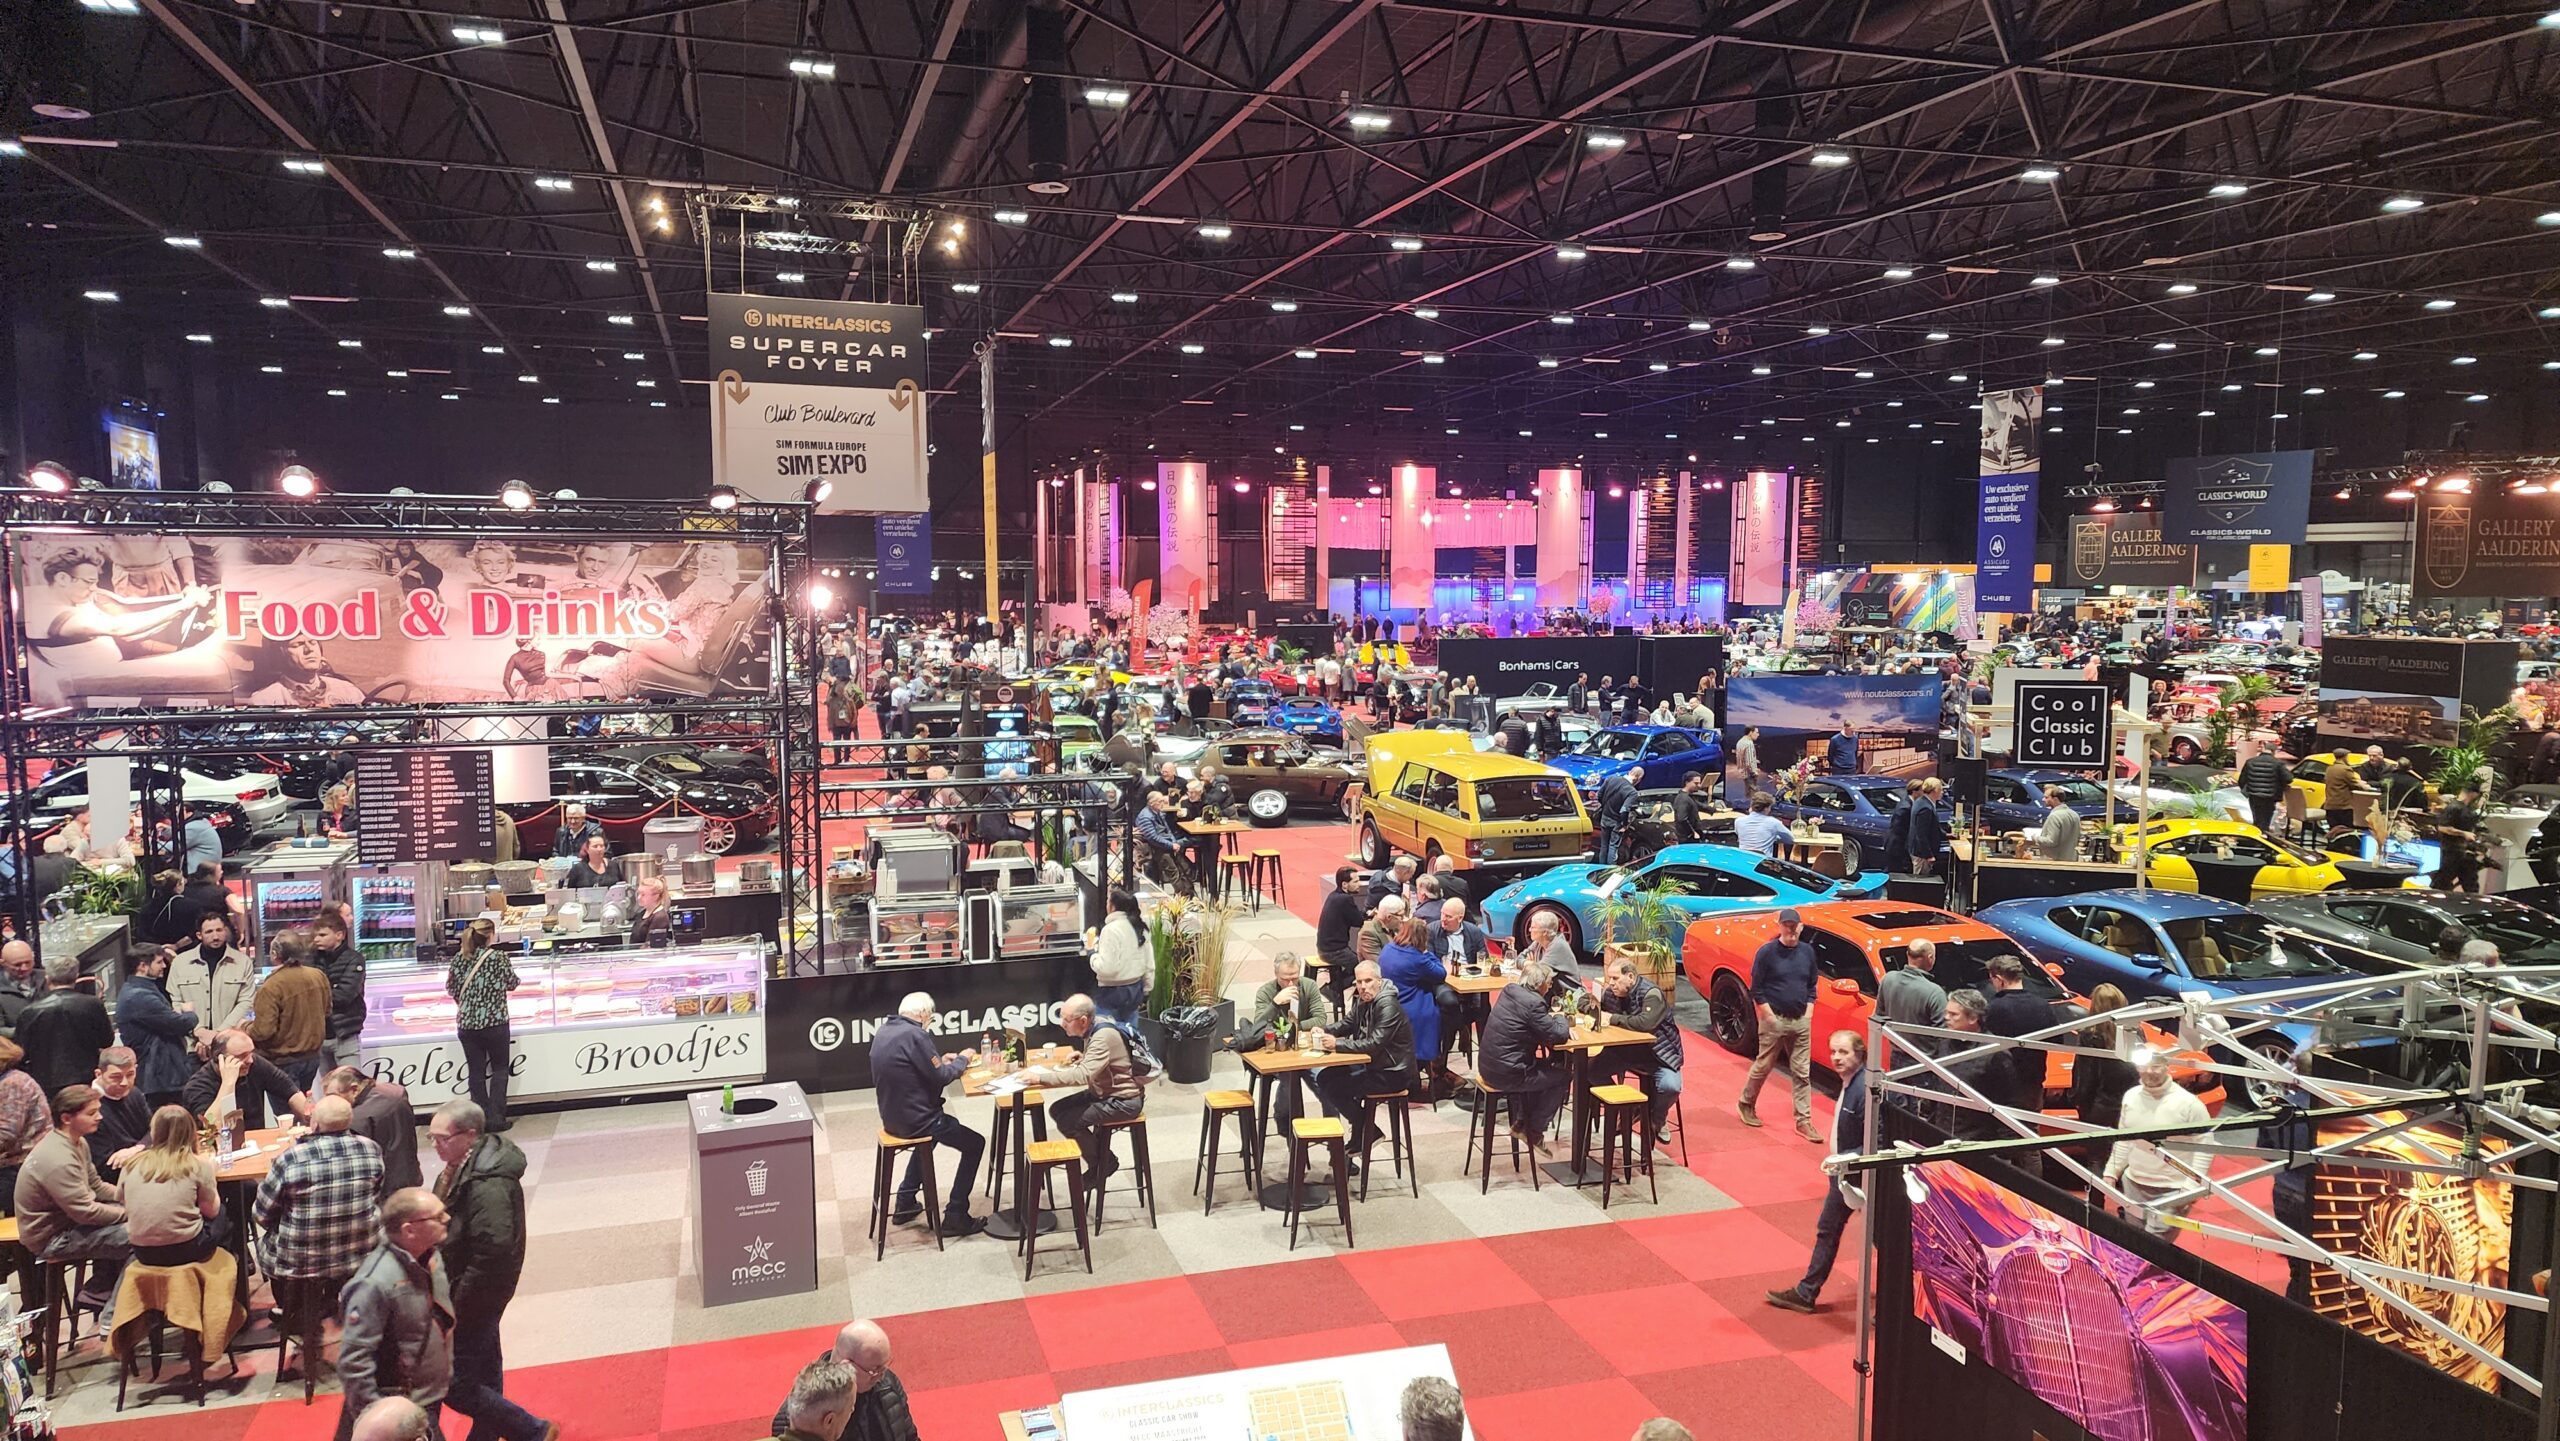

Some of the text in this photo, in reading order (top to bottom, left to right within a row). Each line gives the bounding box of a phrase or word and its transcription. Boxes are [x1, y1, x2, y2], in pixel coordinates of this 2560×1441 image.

[767, 313, 892, 333] INTERCLASSICS
[730, 336, 907, 358] SUPERCAR
[768, 355, 872, 373] FOYER
[764, 403, 876, 427] Club Boulevard
[776, 439, 866, 451] SIM FORMULA EUROPE
[777, 454, 867, 476] SIM EXPO
[1997, 484, 2029, 493] exclusieve
[2198, 490, 2267, 501] CLASSICS-WORLD
[2000, 494, 2026, 503] verdient
[1165, 471, 1179, 552] 日の出の伝説
[1997, 504, 2018, 512] unieke
[2111, 530, 2162, 543] GALLER
[2479, 520, 2555, 536] GALLERY
[2111, 544, 2187, 557] AALDERING
[2476, 540, 2560, 556] AALDERIN
[223, 587, 670, 641] Food & Drinks
[2333, 656, 2450, 670] GALLERY AALDERING
[1844, 688, 1934, 699] www.noutclassiccars.nl
[2031, 694, 2096, 711] Cool
[2030, 717, 2095, 734] Classic
[2030, 739, 2093, 756] Club
[575, 1024, 751, 1077] Broodjes
[732, 1261, 786, 1280] mecc
[1117, 1393, 1225, 1417] INTERCLASSICS
[1129, 1412, 1199, 1428] CLASSIC CAR SHOW
